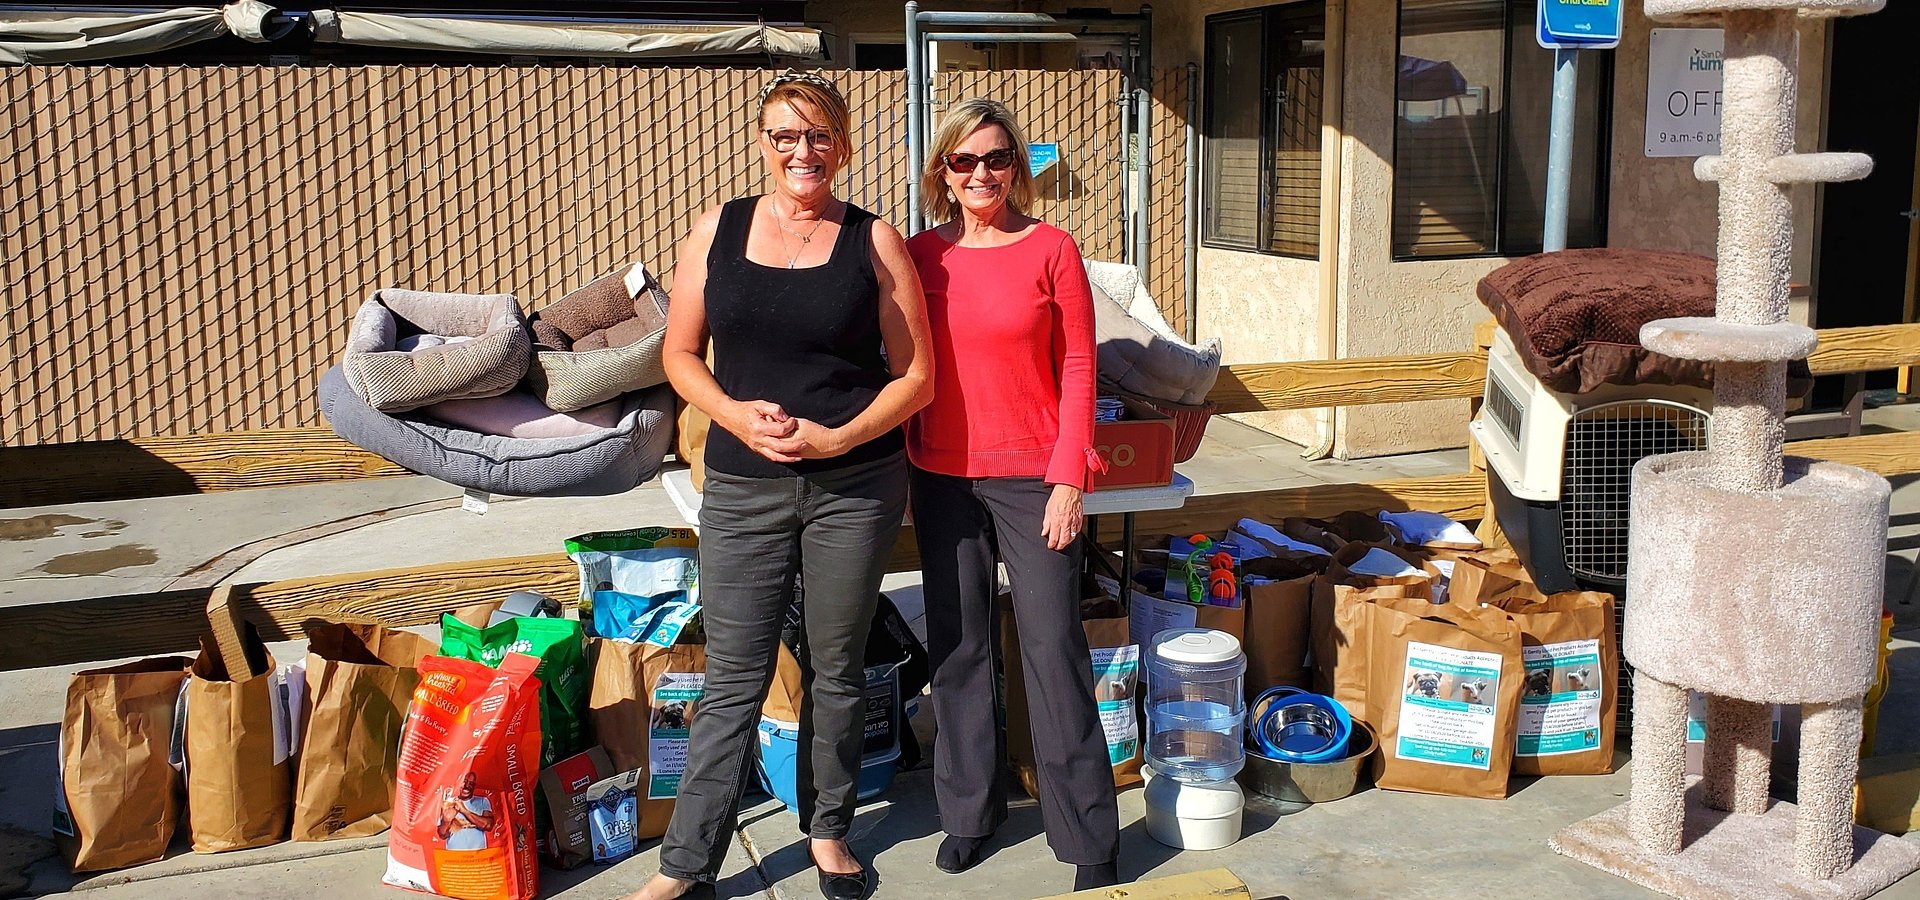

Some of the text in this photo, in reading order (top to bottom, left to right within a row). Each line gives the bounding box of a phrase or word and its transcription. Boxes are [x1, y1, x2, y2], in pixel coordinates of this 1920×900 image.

[1689, 56, 1723, 71] Hum
[1660, 132, 1667, 142] 9
[1670, 131, 1703, 143] a.m.-6
[672, 529, 690, 539] 18.5
[435, 696, 460, 716] BREED
[506, 743, 527, 816] SMALL BREED
[603, 819, 632, 840] Bits
